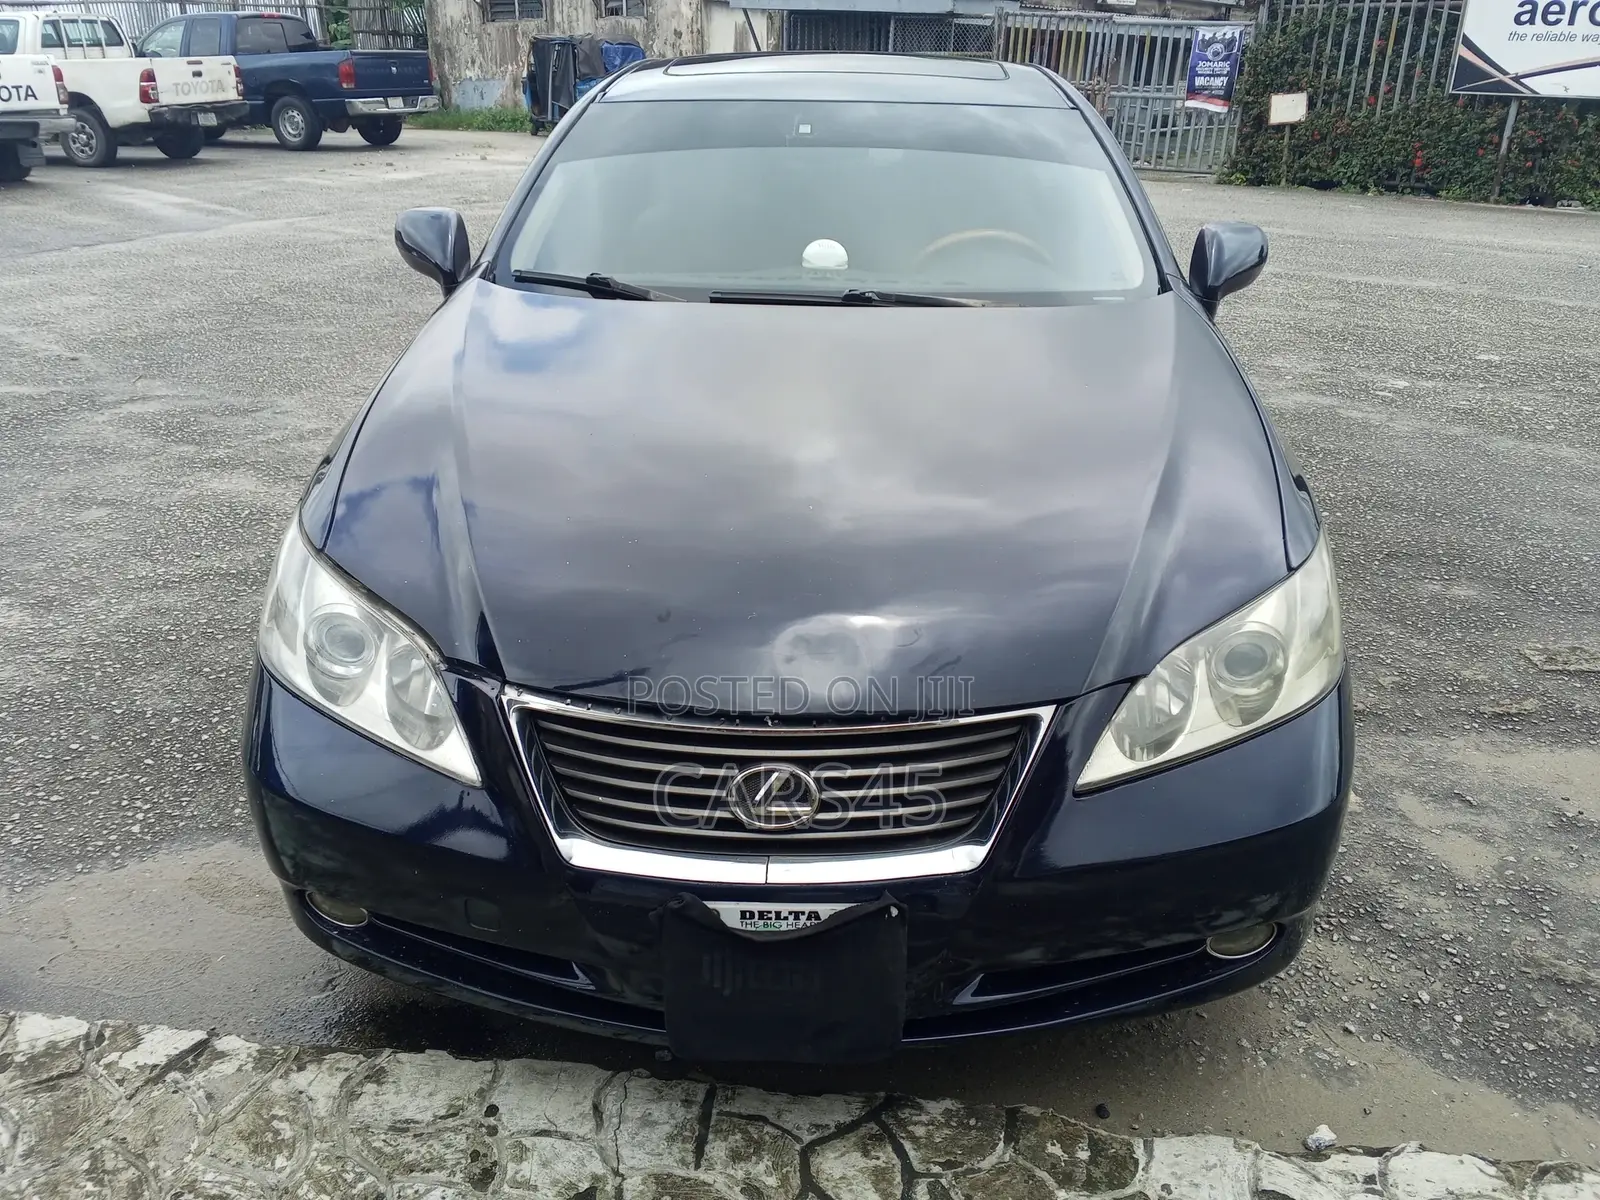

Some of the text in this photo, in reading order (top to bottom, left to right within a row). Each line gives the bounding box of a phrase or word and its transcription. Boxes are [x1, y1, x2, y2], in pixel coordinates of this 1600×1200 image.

[1508, 31, 1600, 46] the reliable wa
[1197, 60, 1231, 68] JOMARIC
[1194, 76, 1229, 87] VACANCY
[172, 79, 226, 97] TOYOTA
[739, 909, 822, 921] DELTA
[740, 920, 760, 929] THE
[762, 921, 783, 929] BIG
